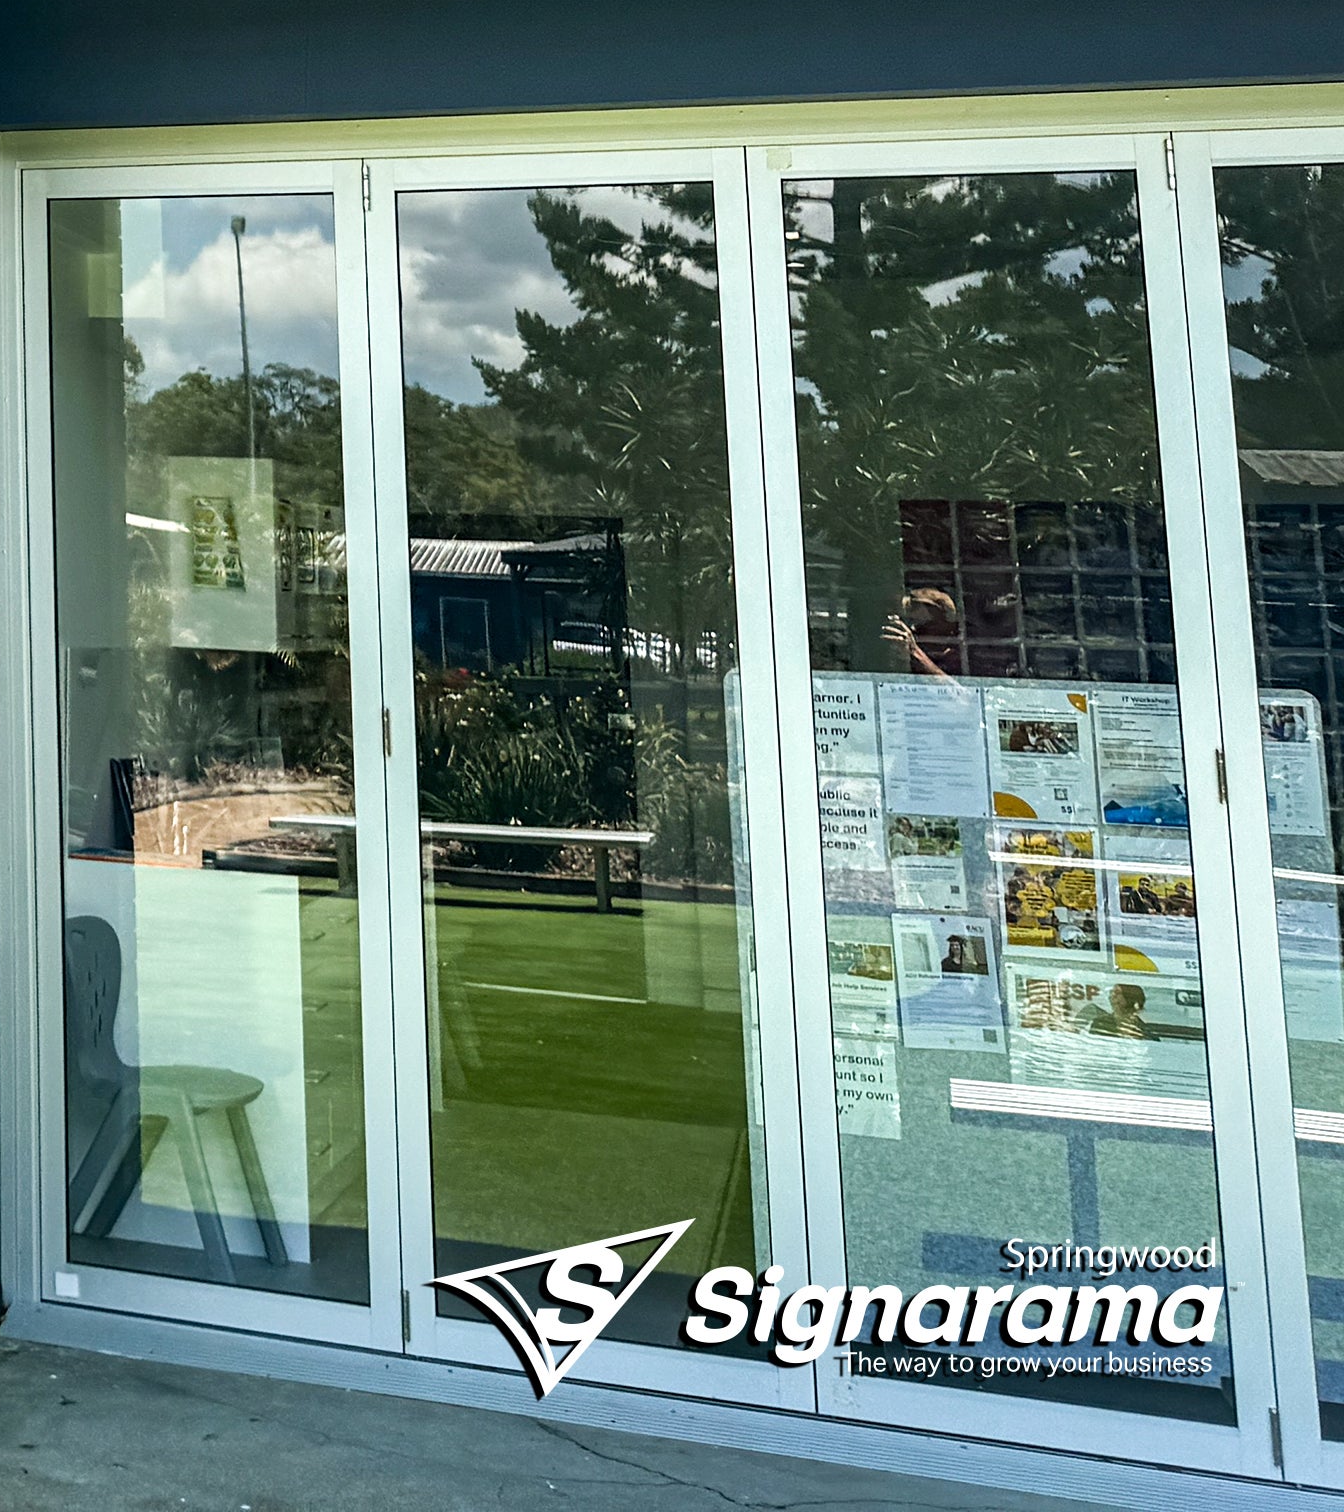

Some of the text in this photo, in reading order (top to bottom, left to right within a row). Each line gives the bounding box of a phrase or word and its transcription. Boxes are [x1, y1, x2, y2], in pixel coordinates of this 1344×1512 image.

[813, 693, 853, 705] arner.
[830, 726, 850, 739] my
[819, 788, 851, 801] ublic
[843, 822, 868, 835] and
[833, 1053, 884, 1067] ersonal
[843, 1088, 894, 1102] my own
